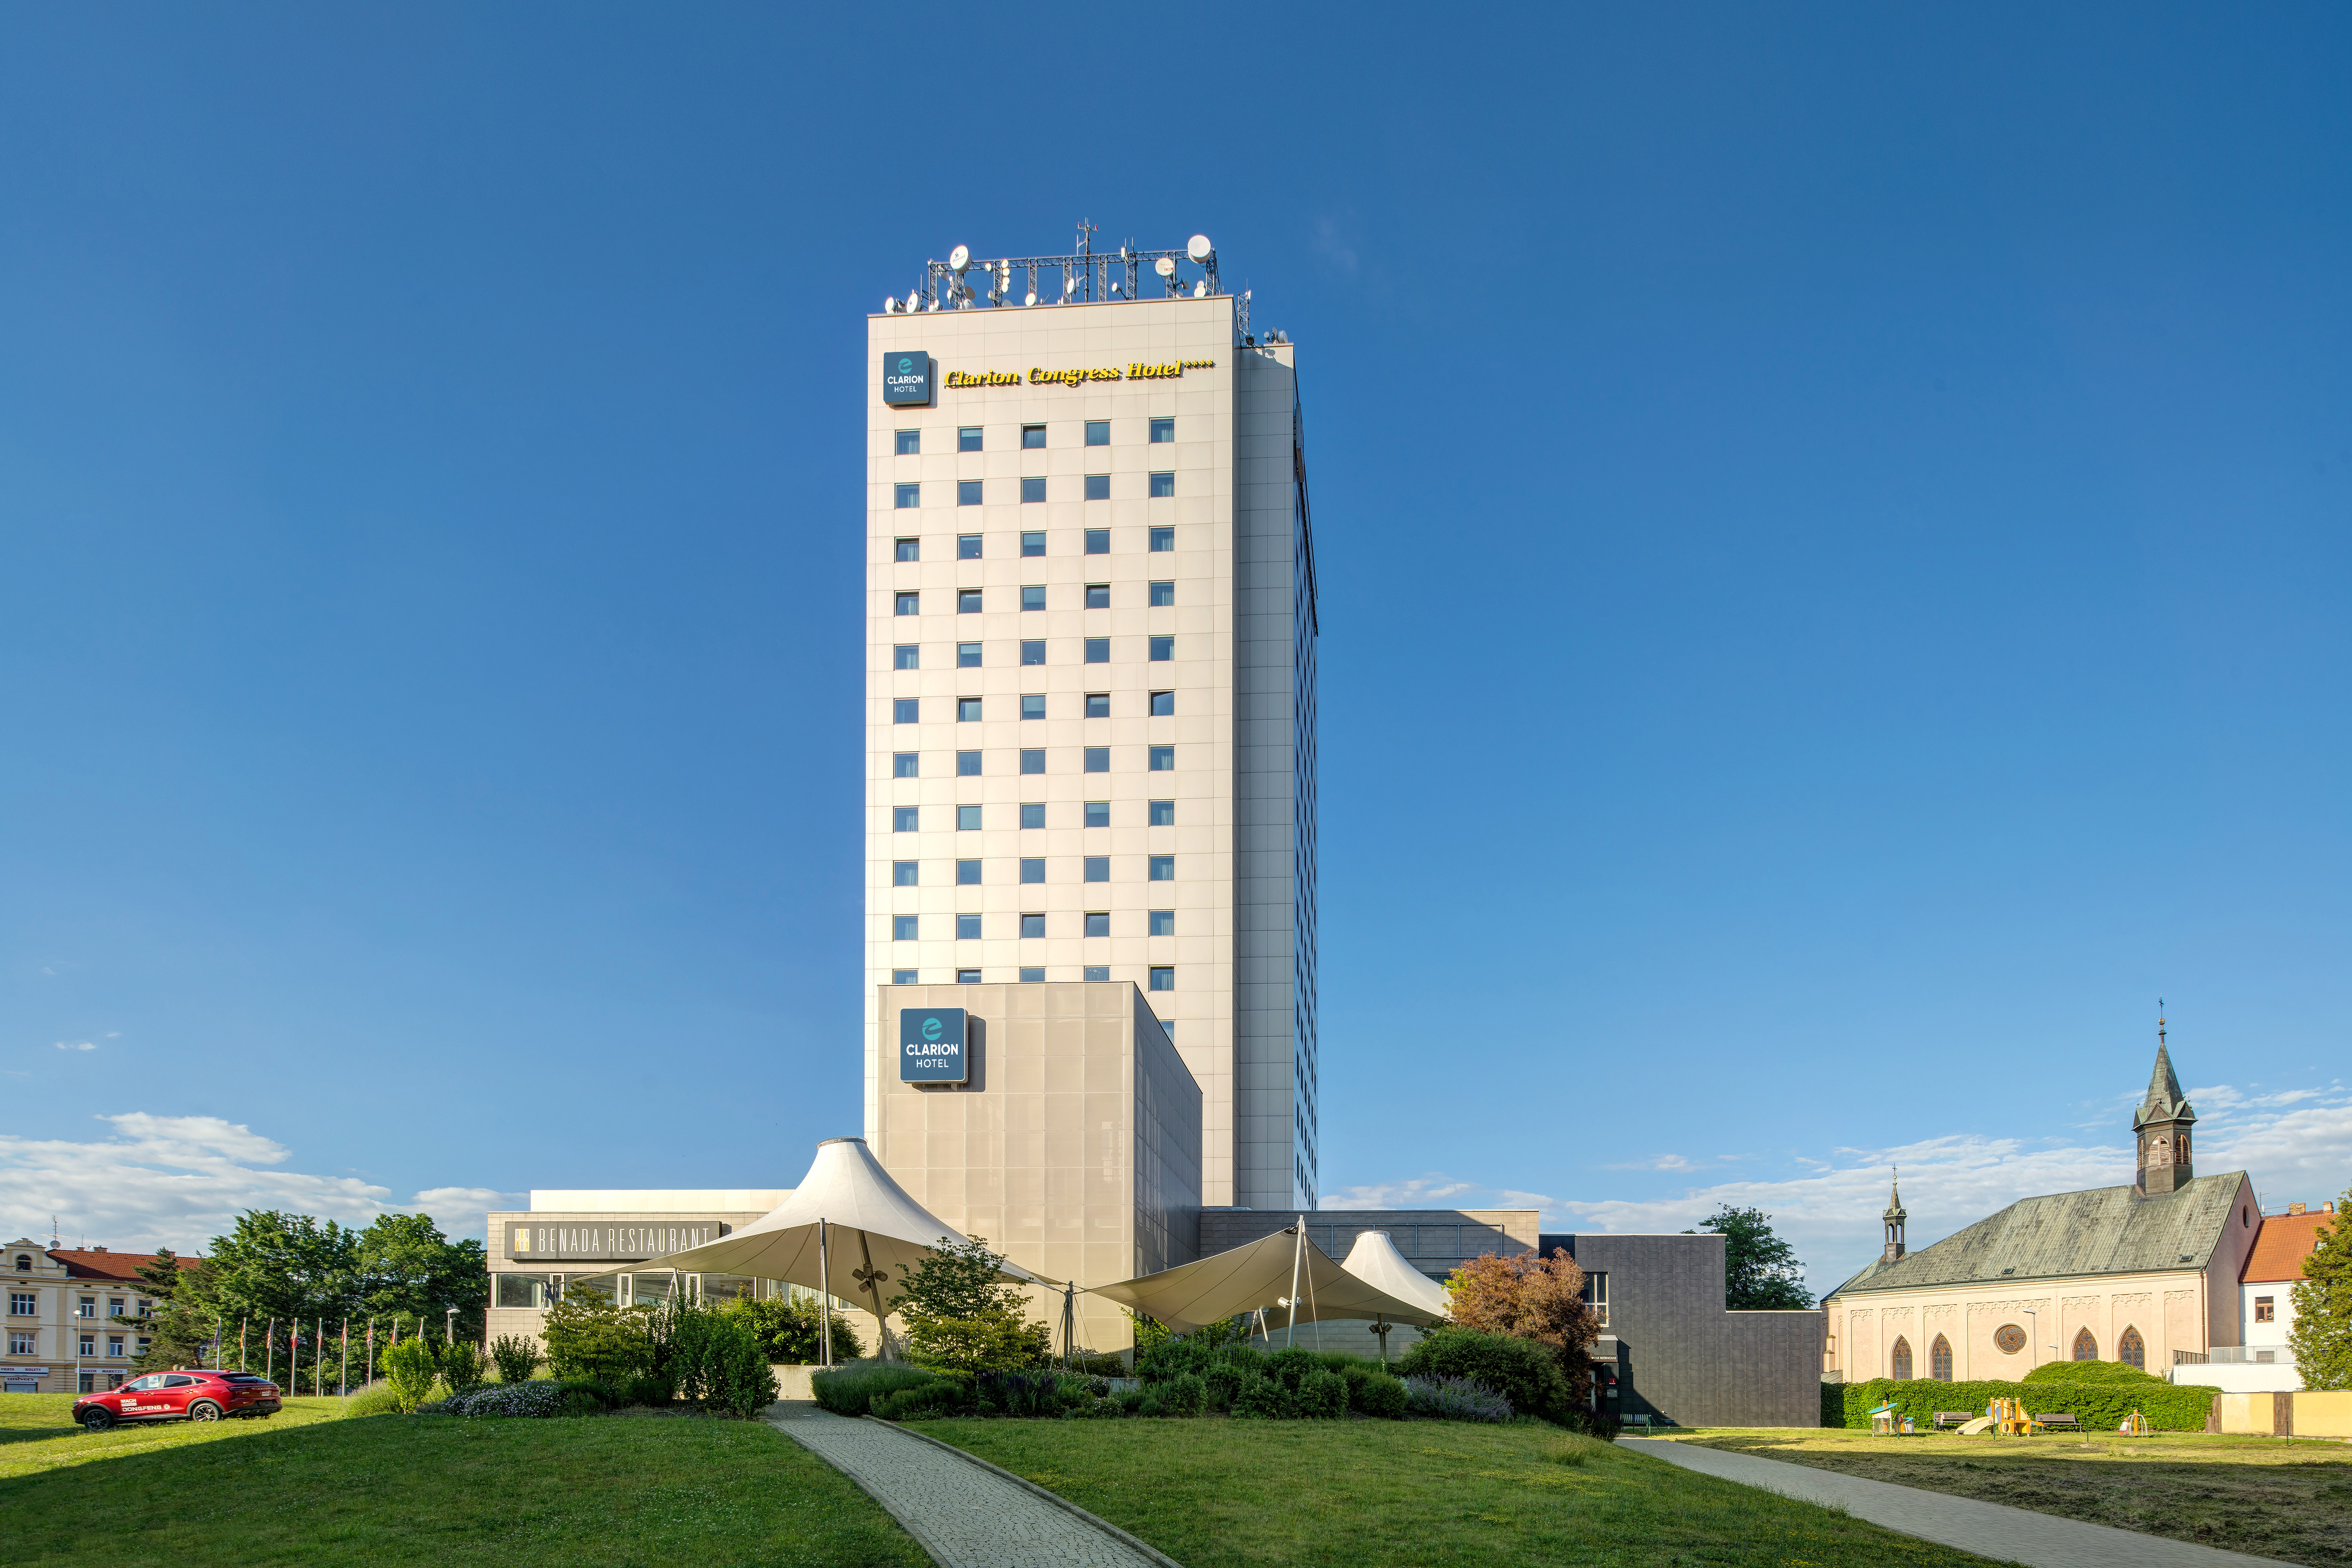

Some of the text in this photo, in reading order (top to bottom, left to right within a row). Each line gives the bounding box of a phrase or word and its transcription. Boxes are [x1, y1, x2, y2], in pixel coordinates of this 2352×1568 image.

[887, 375, 923, 384] CLARION
[944, 368, 1019, 386] Clarion
[1026, 367, 1119, 385] Congress
[906, 1043, 958, 1056] CLARION
[916, 1059, 949, 1068] HOTEL
[539, 1228, 709, 1252] BENADA RESTAURANT
